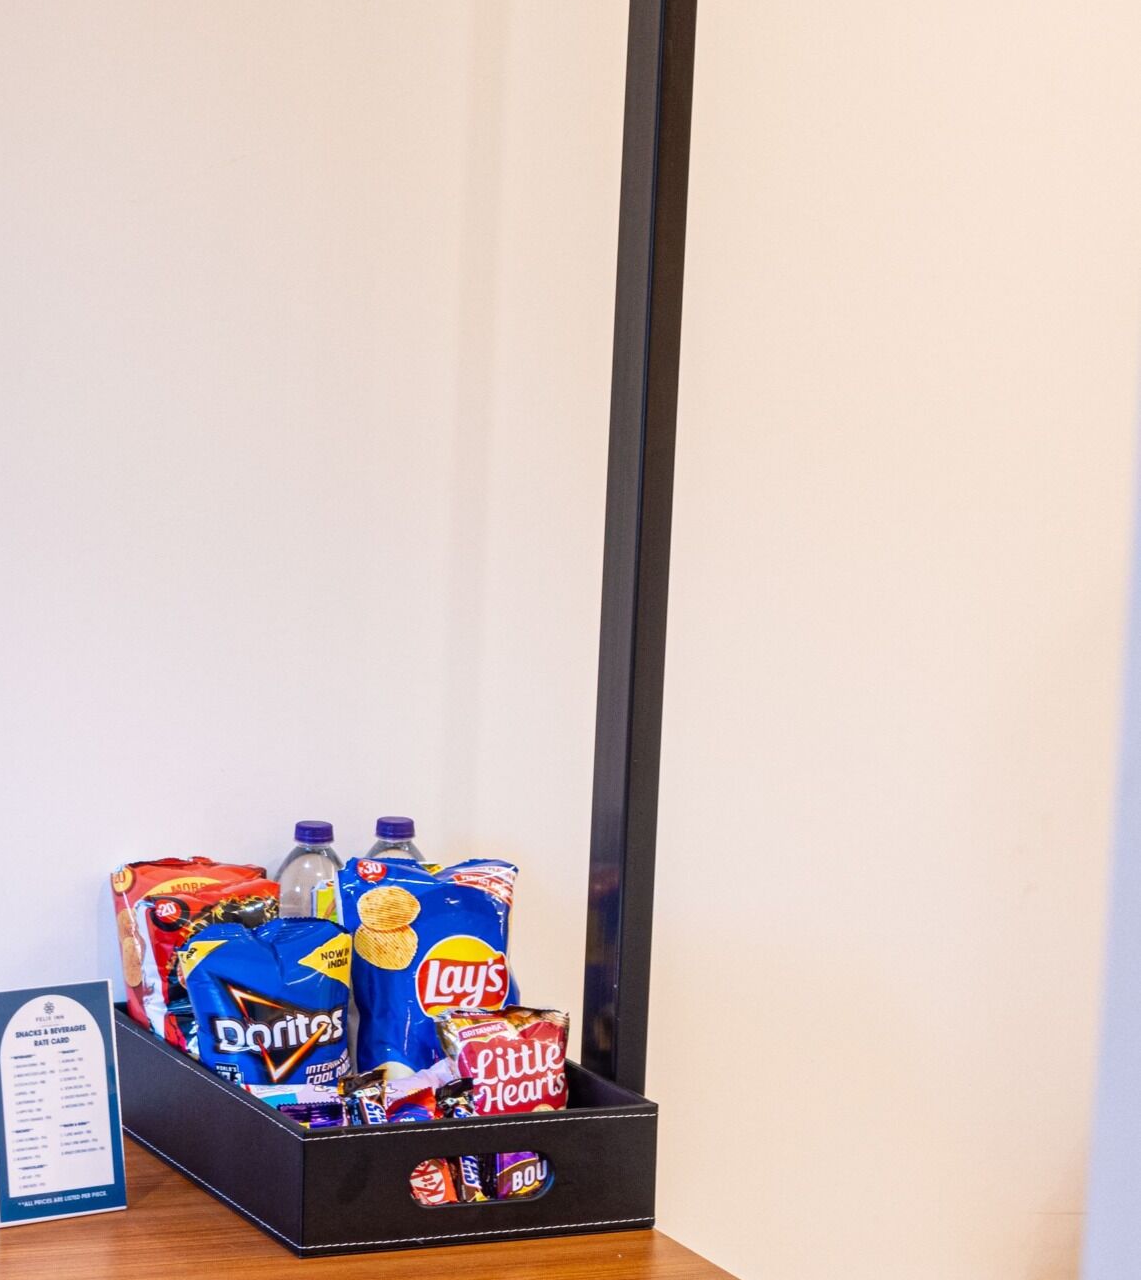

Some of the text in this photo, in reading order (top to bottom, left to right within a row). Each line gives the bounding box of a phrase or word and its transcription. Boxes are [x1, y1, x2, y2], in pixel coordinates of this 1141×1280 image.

[321, 949, 343, 960] NOW
[424, 960, 505, 1008] Lay's
[34, 1038, 49, 1046] RATE
[50, 1024, 86, 1035] BEVERAGES
[215, 1009, 343, 1051] Doritos
[471, 1040, 563, 1085] Little
[476, 1071, 566, 1113] Hearts
